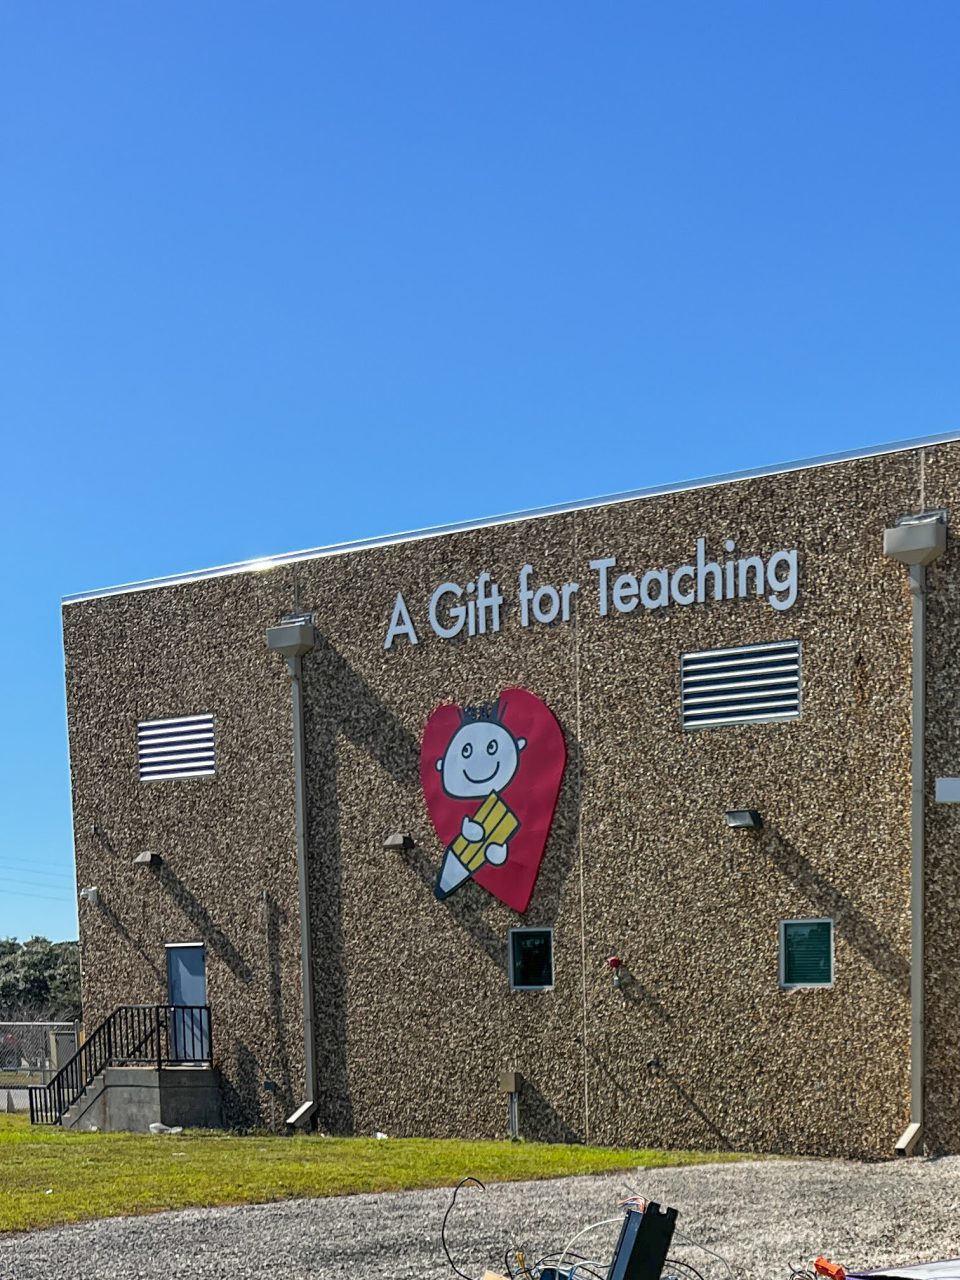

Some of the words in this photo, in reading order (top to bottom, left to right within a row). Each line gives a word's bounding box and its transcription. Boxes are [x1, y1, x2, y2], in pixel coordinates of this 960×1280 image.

[384, 593, 418, 650] A
[429, 573, 503, 639] Gift
[519, 564, 580, 627] for
[590, 538, 799, 616] Teaching
